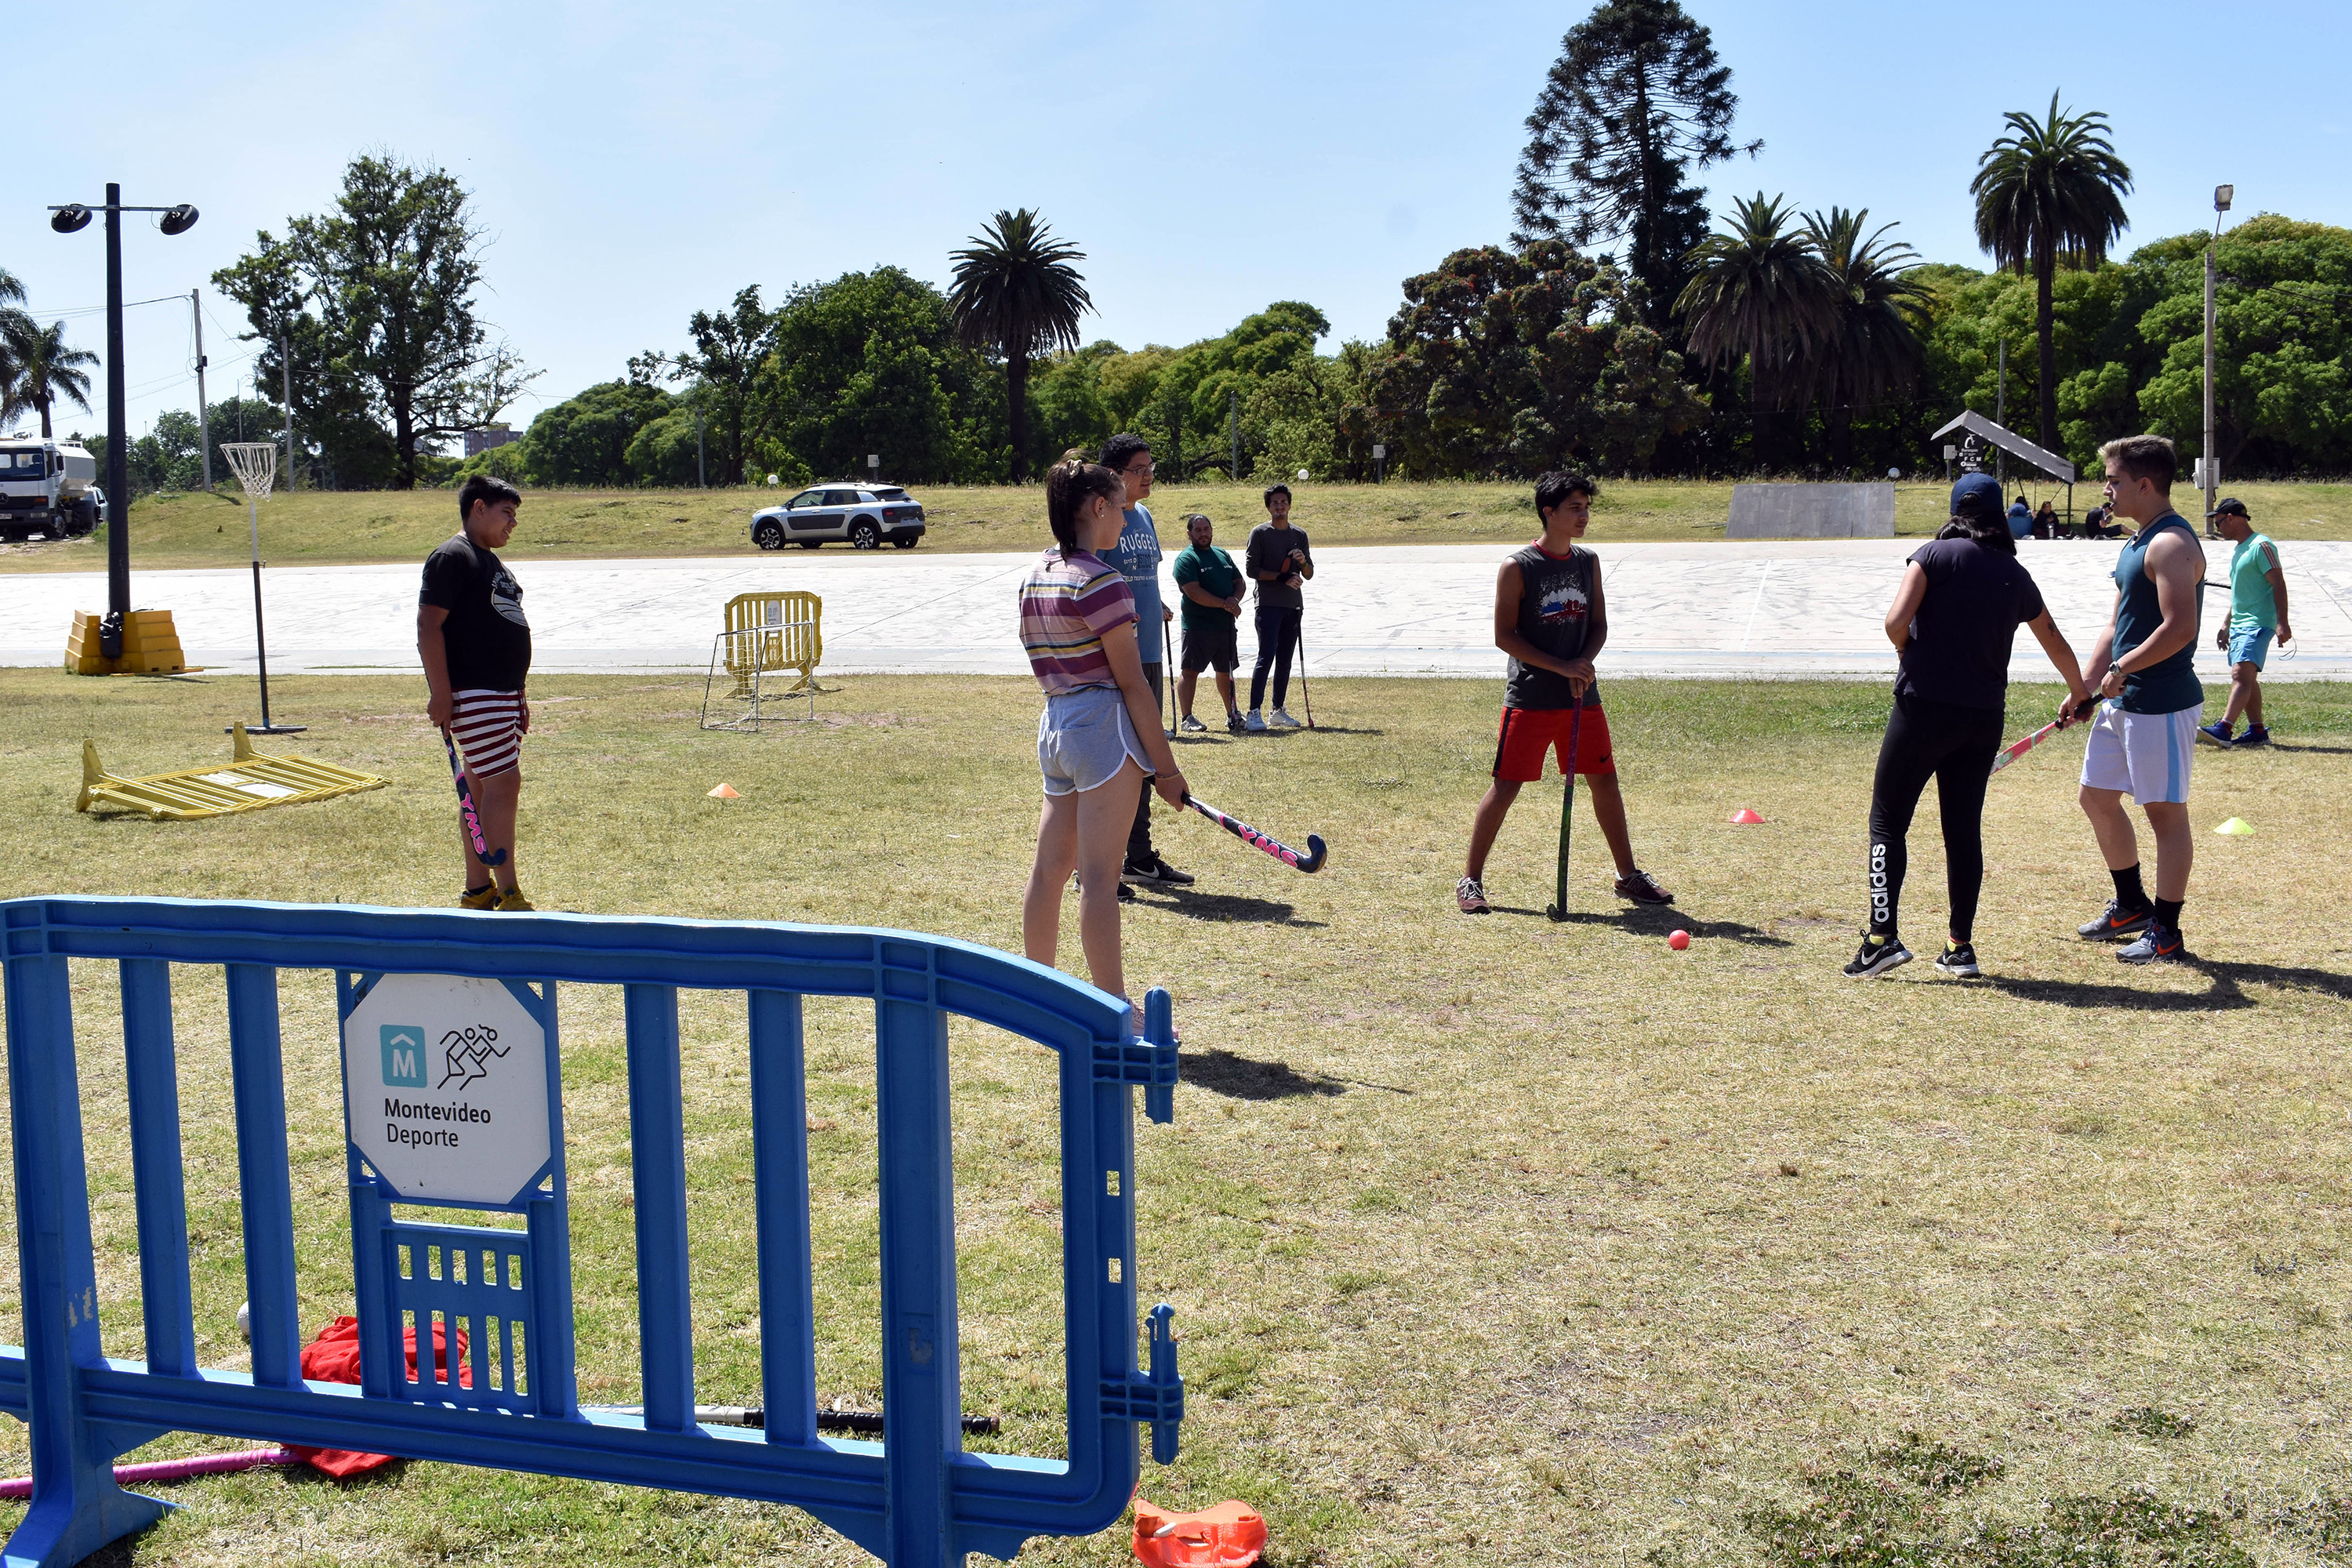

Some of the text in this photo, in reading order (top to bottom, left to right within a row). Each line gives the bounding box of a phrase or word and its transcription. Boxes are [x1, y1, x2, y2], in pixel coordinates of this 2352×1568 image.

[1120, 533, 1157, 554] RUGGED
[1870, 844, 1889, 923] adidas
[392, 1049, 417, 1078] M
[384, 1098, 492, 1123] Montevideo
[387, 1123, 459, 1149] Deporte
